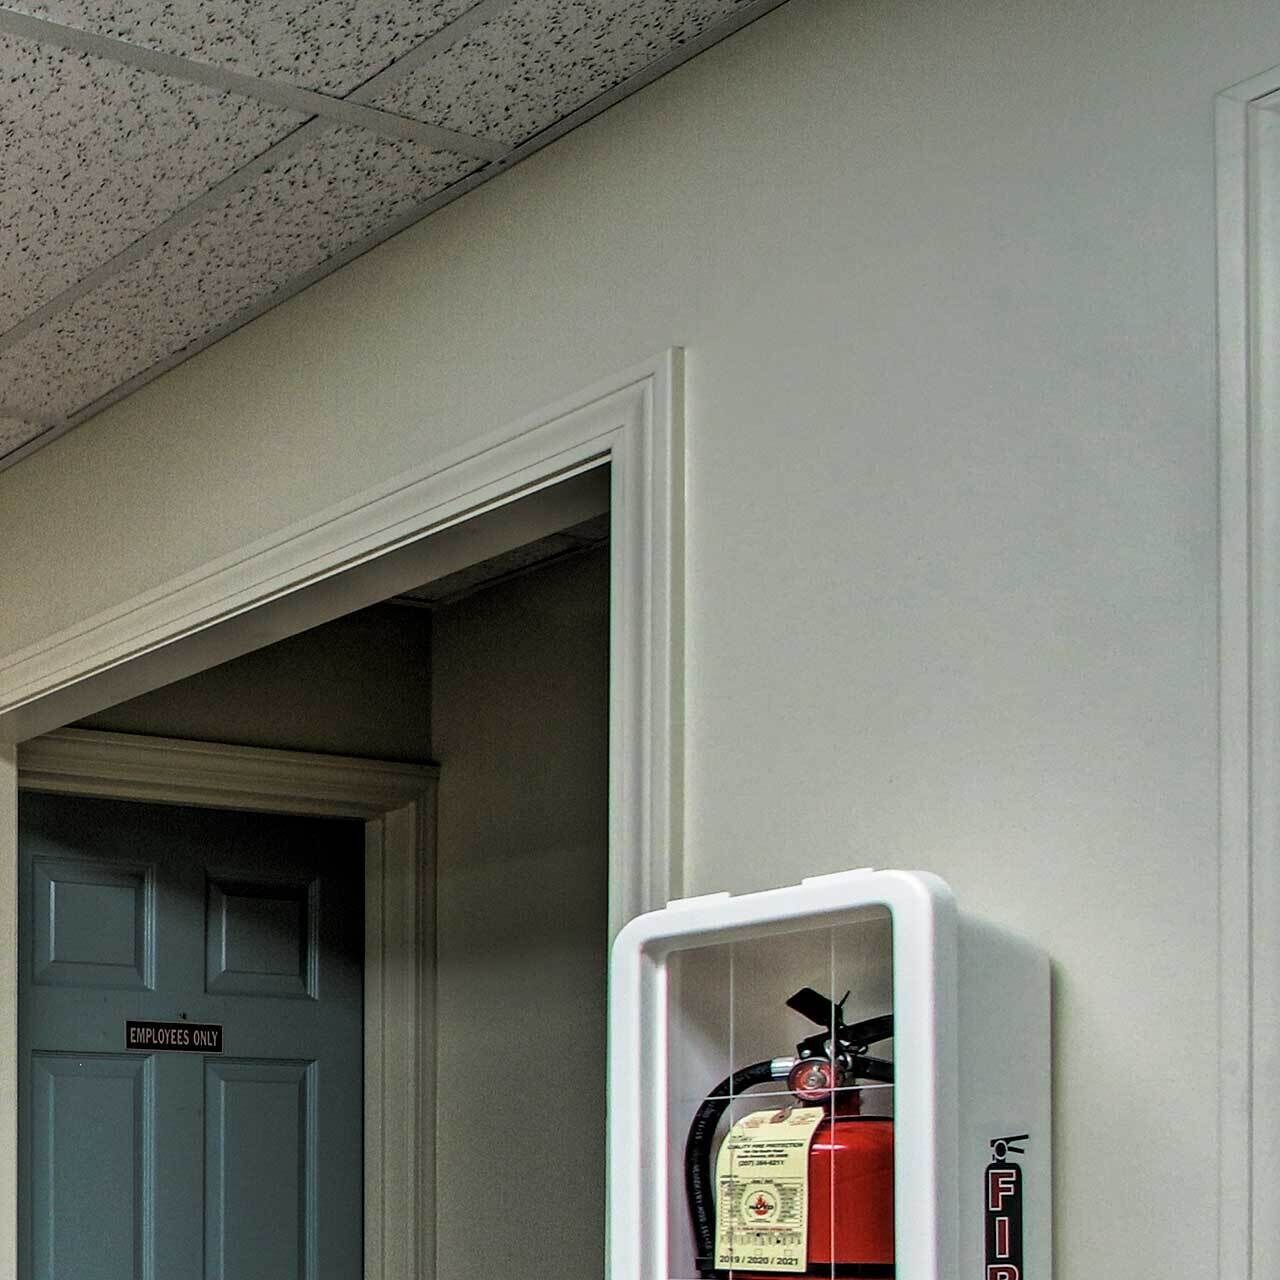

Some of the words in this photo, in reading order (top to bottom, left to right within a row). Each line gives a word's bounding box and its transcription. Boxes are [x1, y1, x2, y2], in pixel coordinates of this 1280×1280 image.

[130, 1027, 190, 1045] EMPLOYEES
[193, 1030, 218, 1047] ONLY
[720, 1255, 740, 1263] 2019
[747, 1256, 769, 1264] 2020
[776, 1257, 799, 1265] 2021
